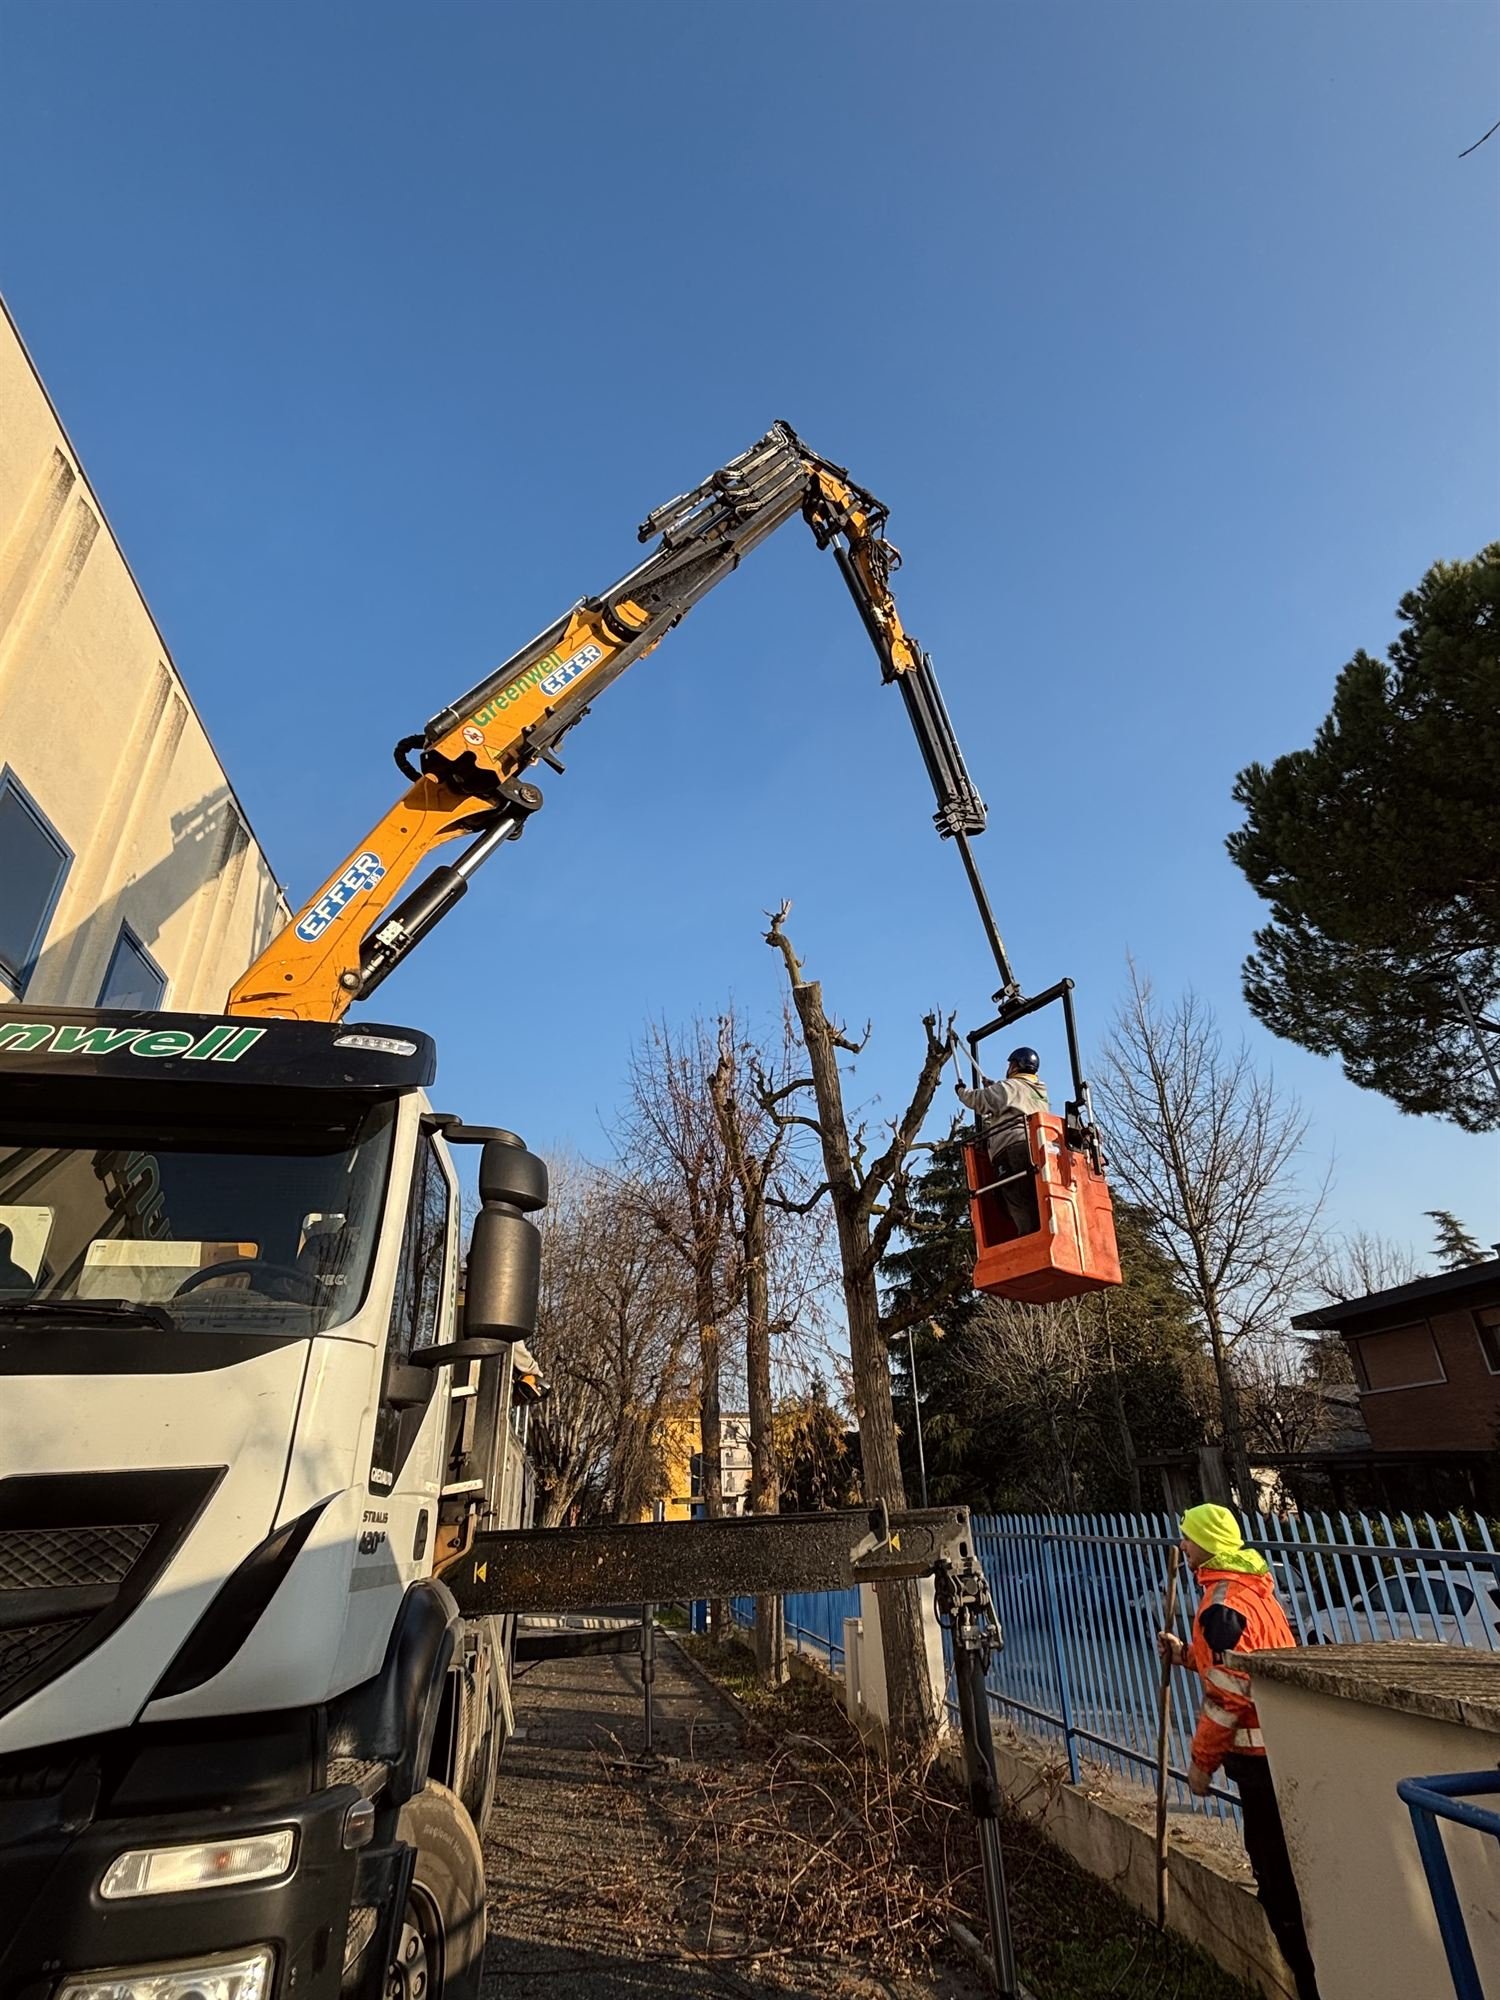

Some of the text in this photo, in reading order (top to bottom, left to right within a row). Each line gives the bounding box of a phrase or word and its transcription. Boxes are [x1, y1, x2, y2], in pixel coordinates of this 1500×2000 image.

[470, 651, 563, 727] Greenwell
[543, 645, 600, 694] EFFER
[299, 854, 379, 937] EFFER
[362, 1510, 389, 1524] STRALIS
